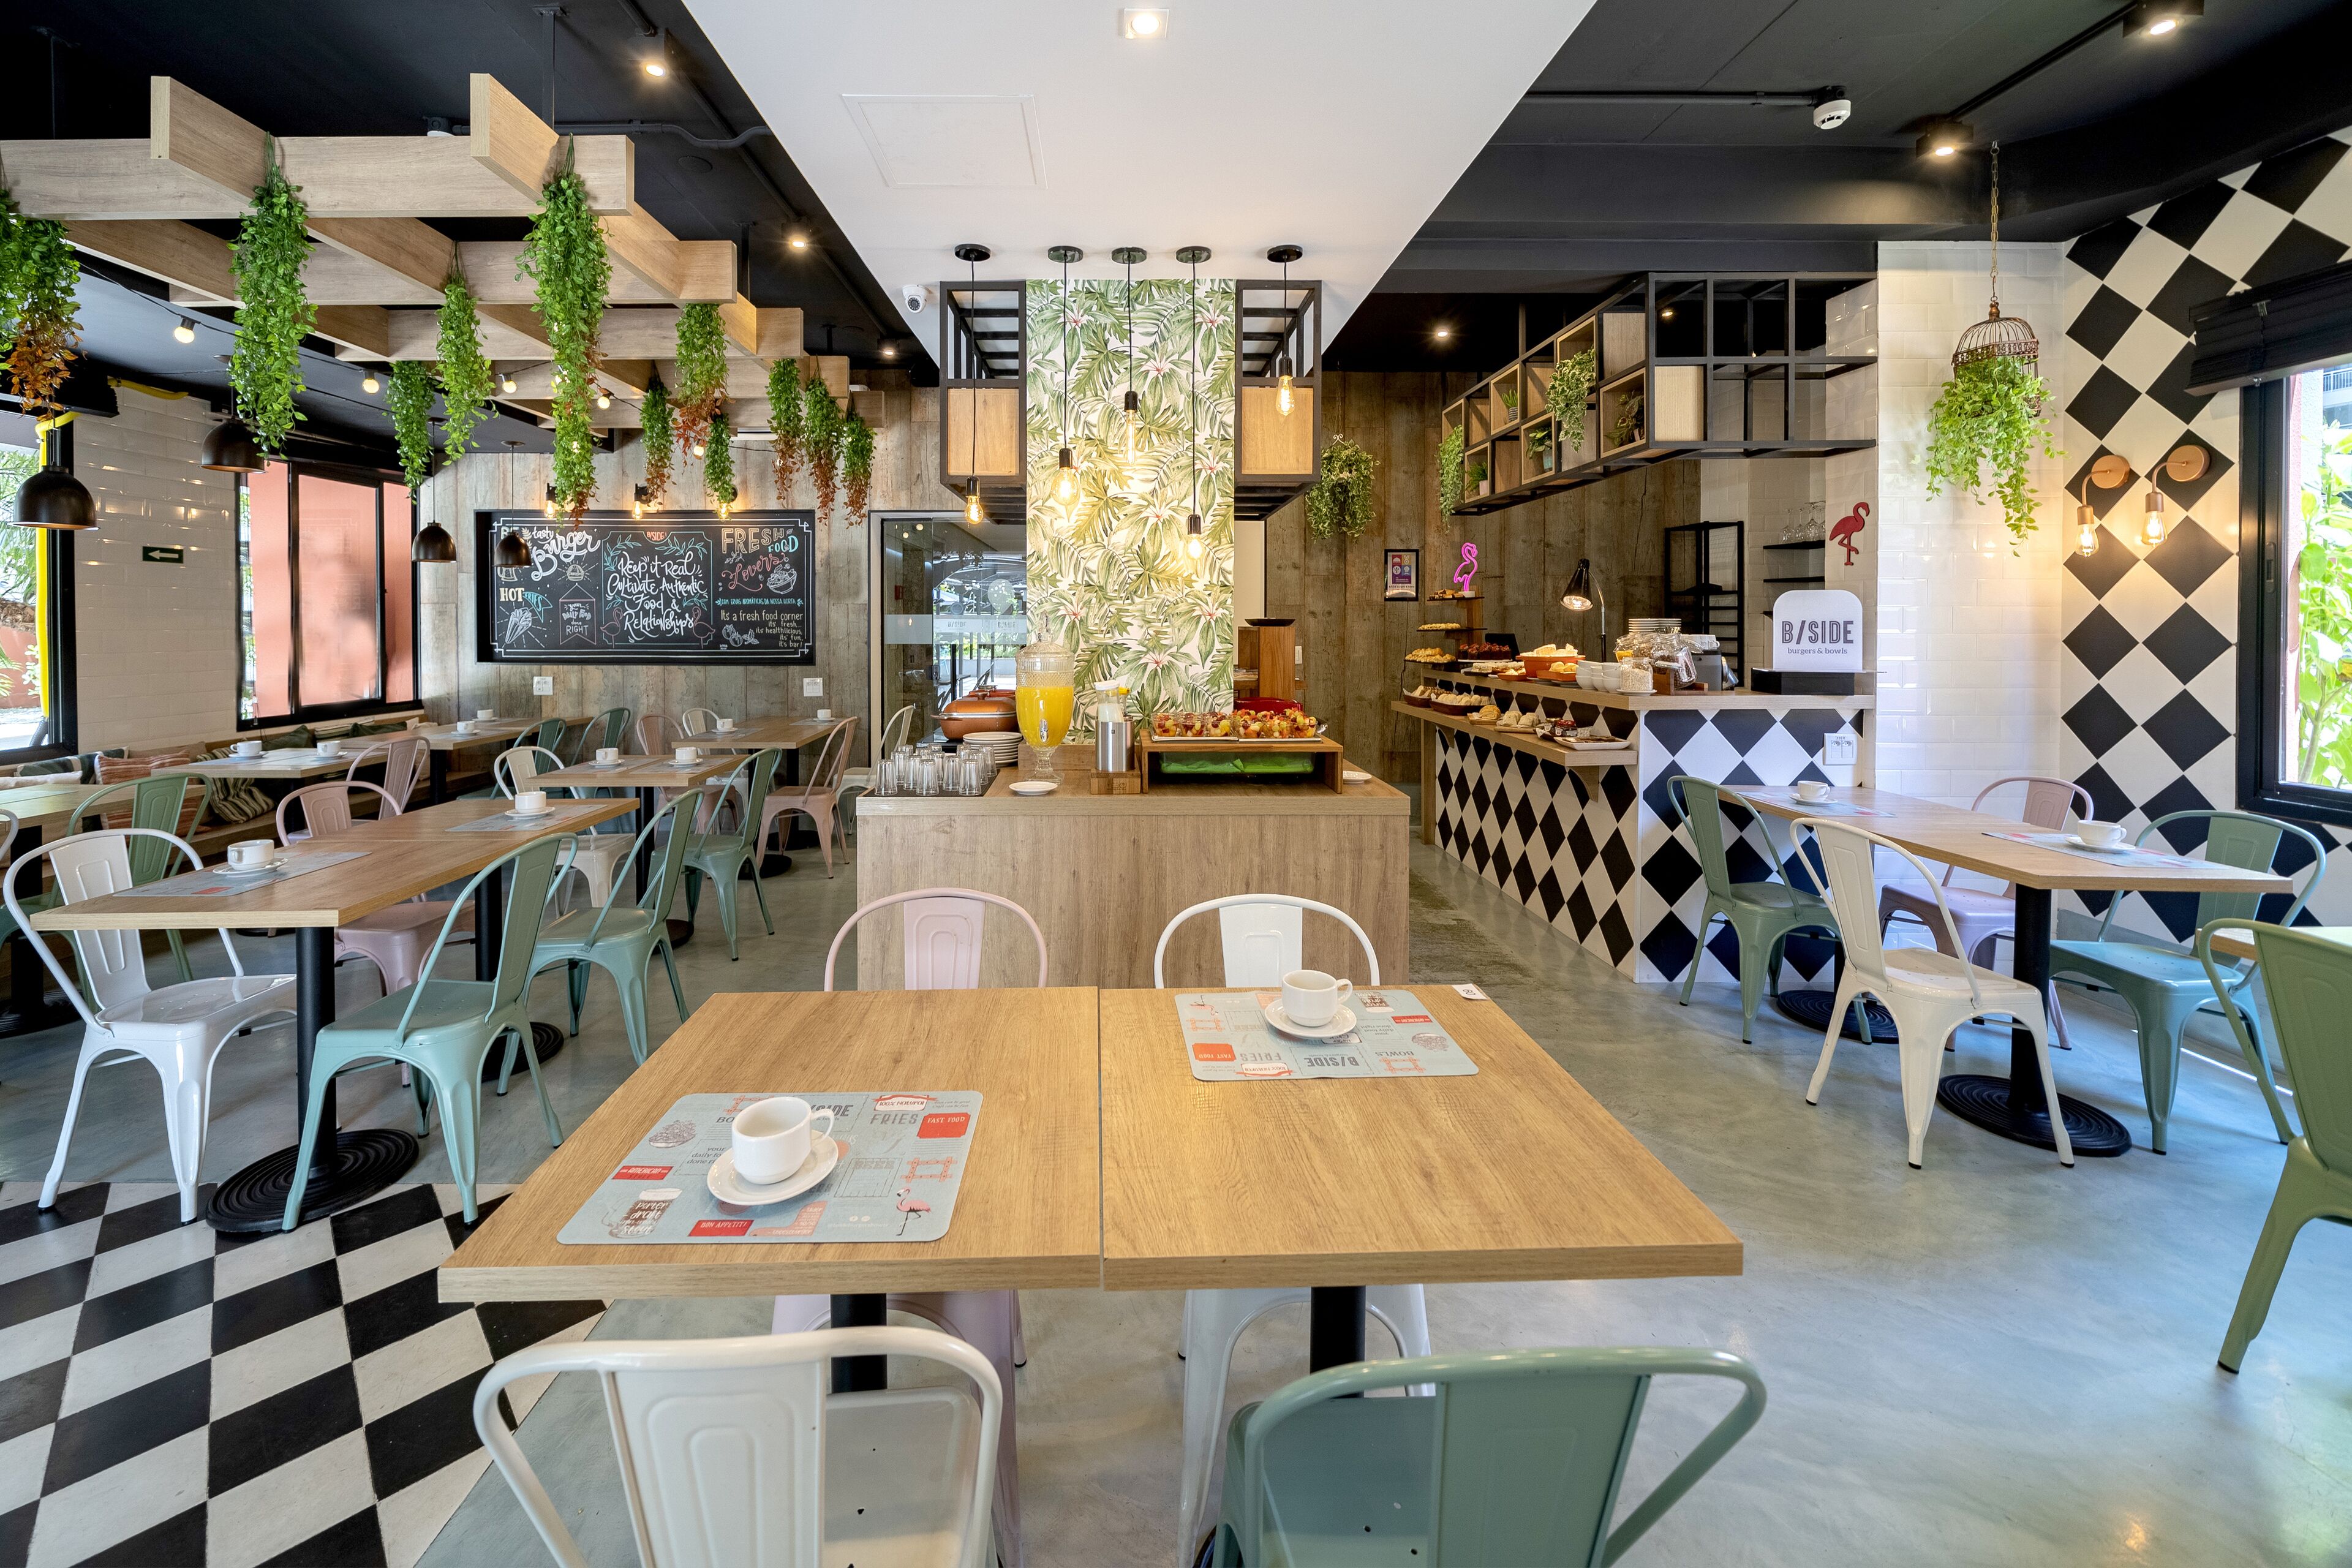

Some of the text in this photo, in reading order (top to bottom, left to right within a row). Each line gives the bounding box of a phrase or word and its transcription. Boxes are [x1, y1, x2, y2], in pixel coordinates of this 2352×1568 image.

[532, 526, 554, 543] tasty
[722, 528, 785, 554] FRESH
[768, 535, 799, 552] FOOD
[531, 530, 601, 581] Burger
[617, 551, 696, 579] Keep it Real
[722, 552, 785, 592] Lovers
[499, 587, 525, 601] HOT
[608, 573, 707, 598] Cultivate Authentic
[524, 592, 543, 612] FRIES
[624, 593, 681, 614] Food &
[739, 610, 760, 621] fresh
[762, 610, 778, 620] food
[566, 625, 589, 636] RIGHT
[1782, 620, 1854, 645] B/SIDE
[1240, 1052, 1281, 1061] FRIES
[1303, 1057, 1359, 1067] B/SIDE
[870, 1114, 918, 1125] FRIES
[630, 1210, 662, 1219] draft
